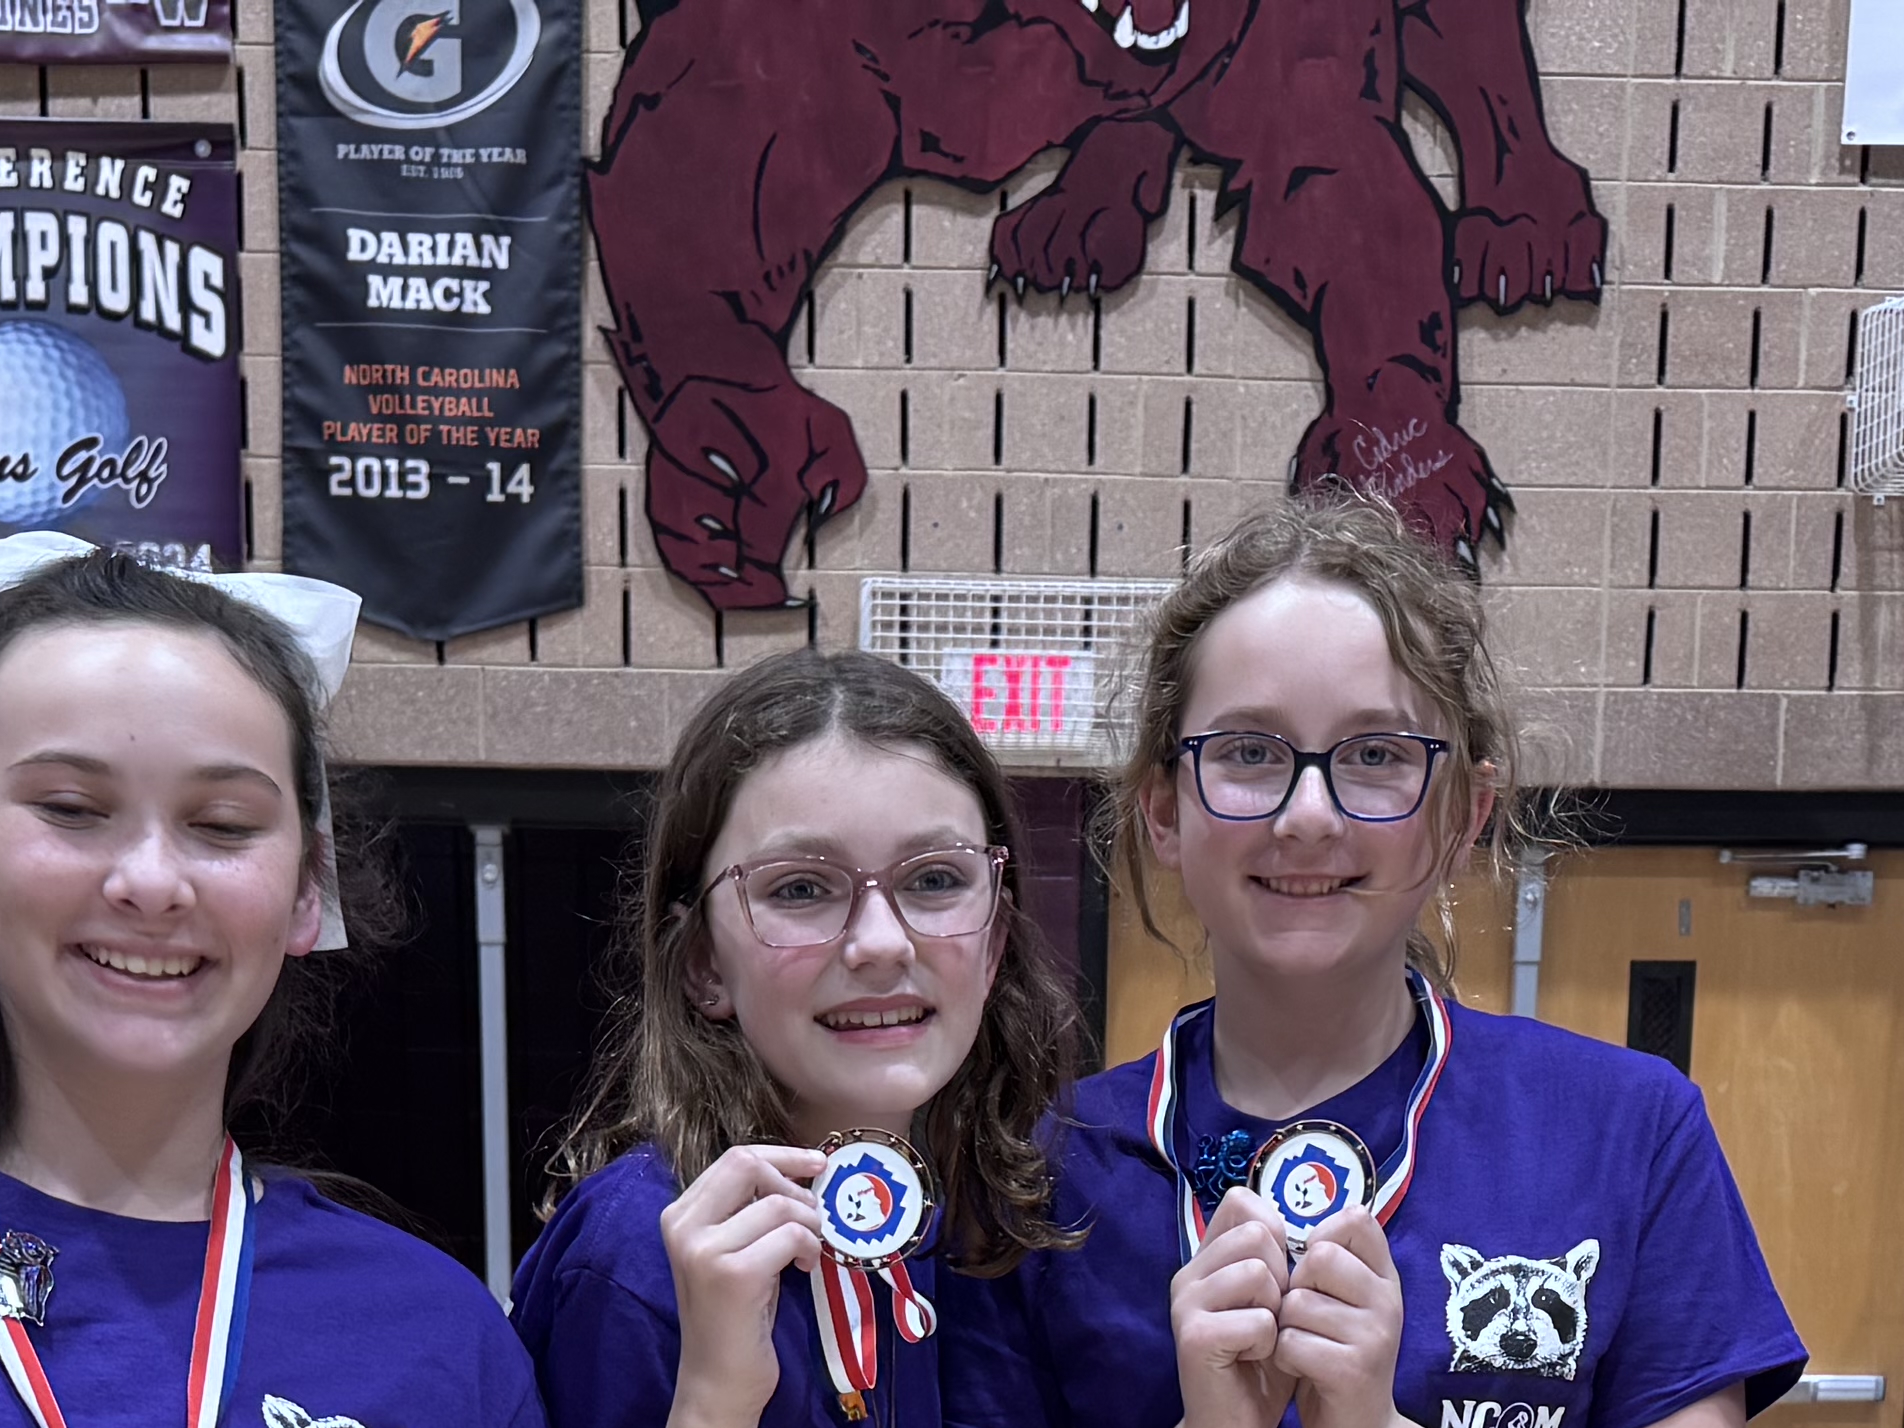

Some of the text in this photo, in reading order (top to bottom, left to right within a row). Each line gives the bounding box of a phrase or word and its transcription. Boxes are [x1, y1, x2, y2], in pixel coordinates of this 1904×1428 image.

[336, 143, 527, 165] PLAYER OF THE YEAR
[346, 227, 512, 270] DARIAN
[366, 273, 492, 314] MACK
[343, 364, 520, 389] NORTH CAROLINA
[368, 394, 494, 418] VOLLEYBALL
[322, 420, 540, 449] PLAYER OF THE YEAR
[54, 435, 169, 509] Golf
[328, 455, 430, 500] 2013
[485, 461, 535, 504] 14
[971, 653, 1073, 735] EXIT
